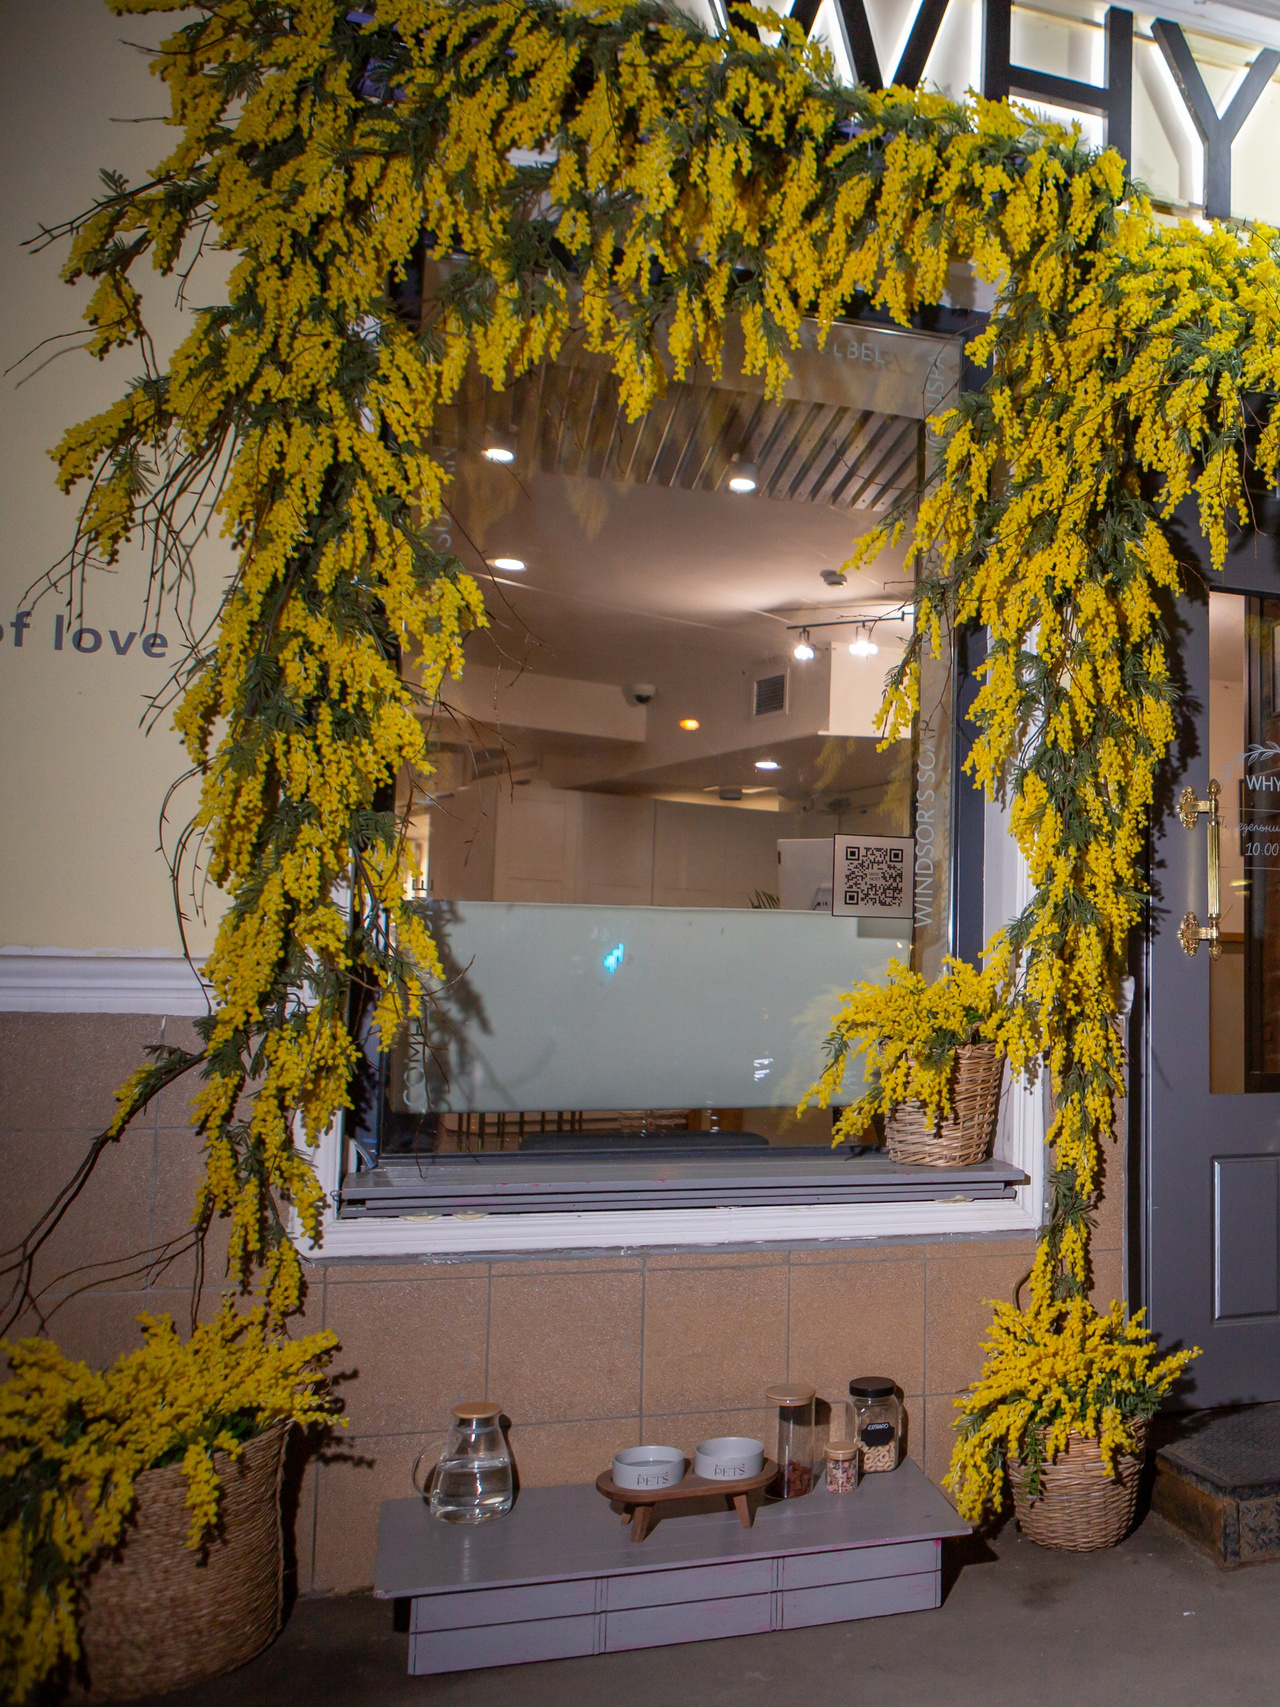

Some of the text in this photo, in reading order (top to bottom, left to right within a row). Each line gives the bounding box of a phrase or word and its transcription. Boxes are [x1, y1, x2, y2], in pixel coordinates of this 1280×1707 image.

[0, 611, 169, 658] f love
[1245, 842, 1280, 857] 10:00
[914, 789, 935, 928] WINDSOR'S
[714, 1463, 746, 1476] PETS
[637, 1472, 669, 1486] PETS
